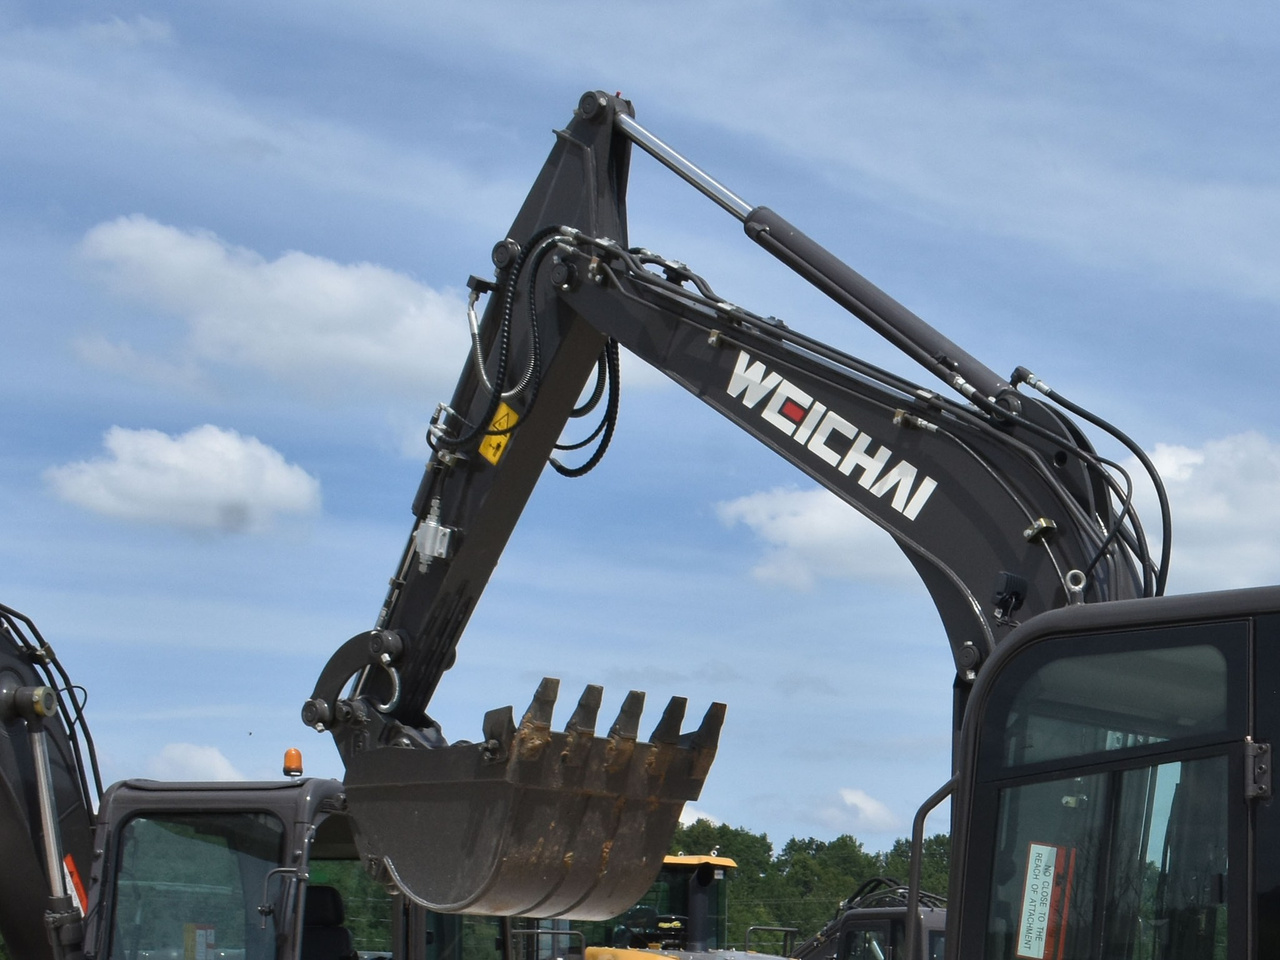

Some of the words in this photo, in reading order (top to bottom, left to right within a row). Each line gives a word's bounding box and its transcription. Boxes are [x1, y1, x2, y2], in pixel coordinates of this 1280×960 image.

[726, 350, 938, 521] WEICHAI
[1033, 852, 1043, 880] REACH
[1043, 864, 1052, 877] NO
[1030, 883, 1039, 895] OF
[1040, 880, 1050, 908] CLOSE
[1024, 898, 1037, 950] ATTACHMENT
[1037, 911, 1046, 923] TO
[1035, 926, 1044, 942] THE
